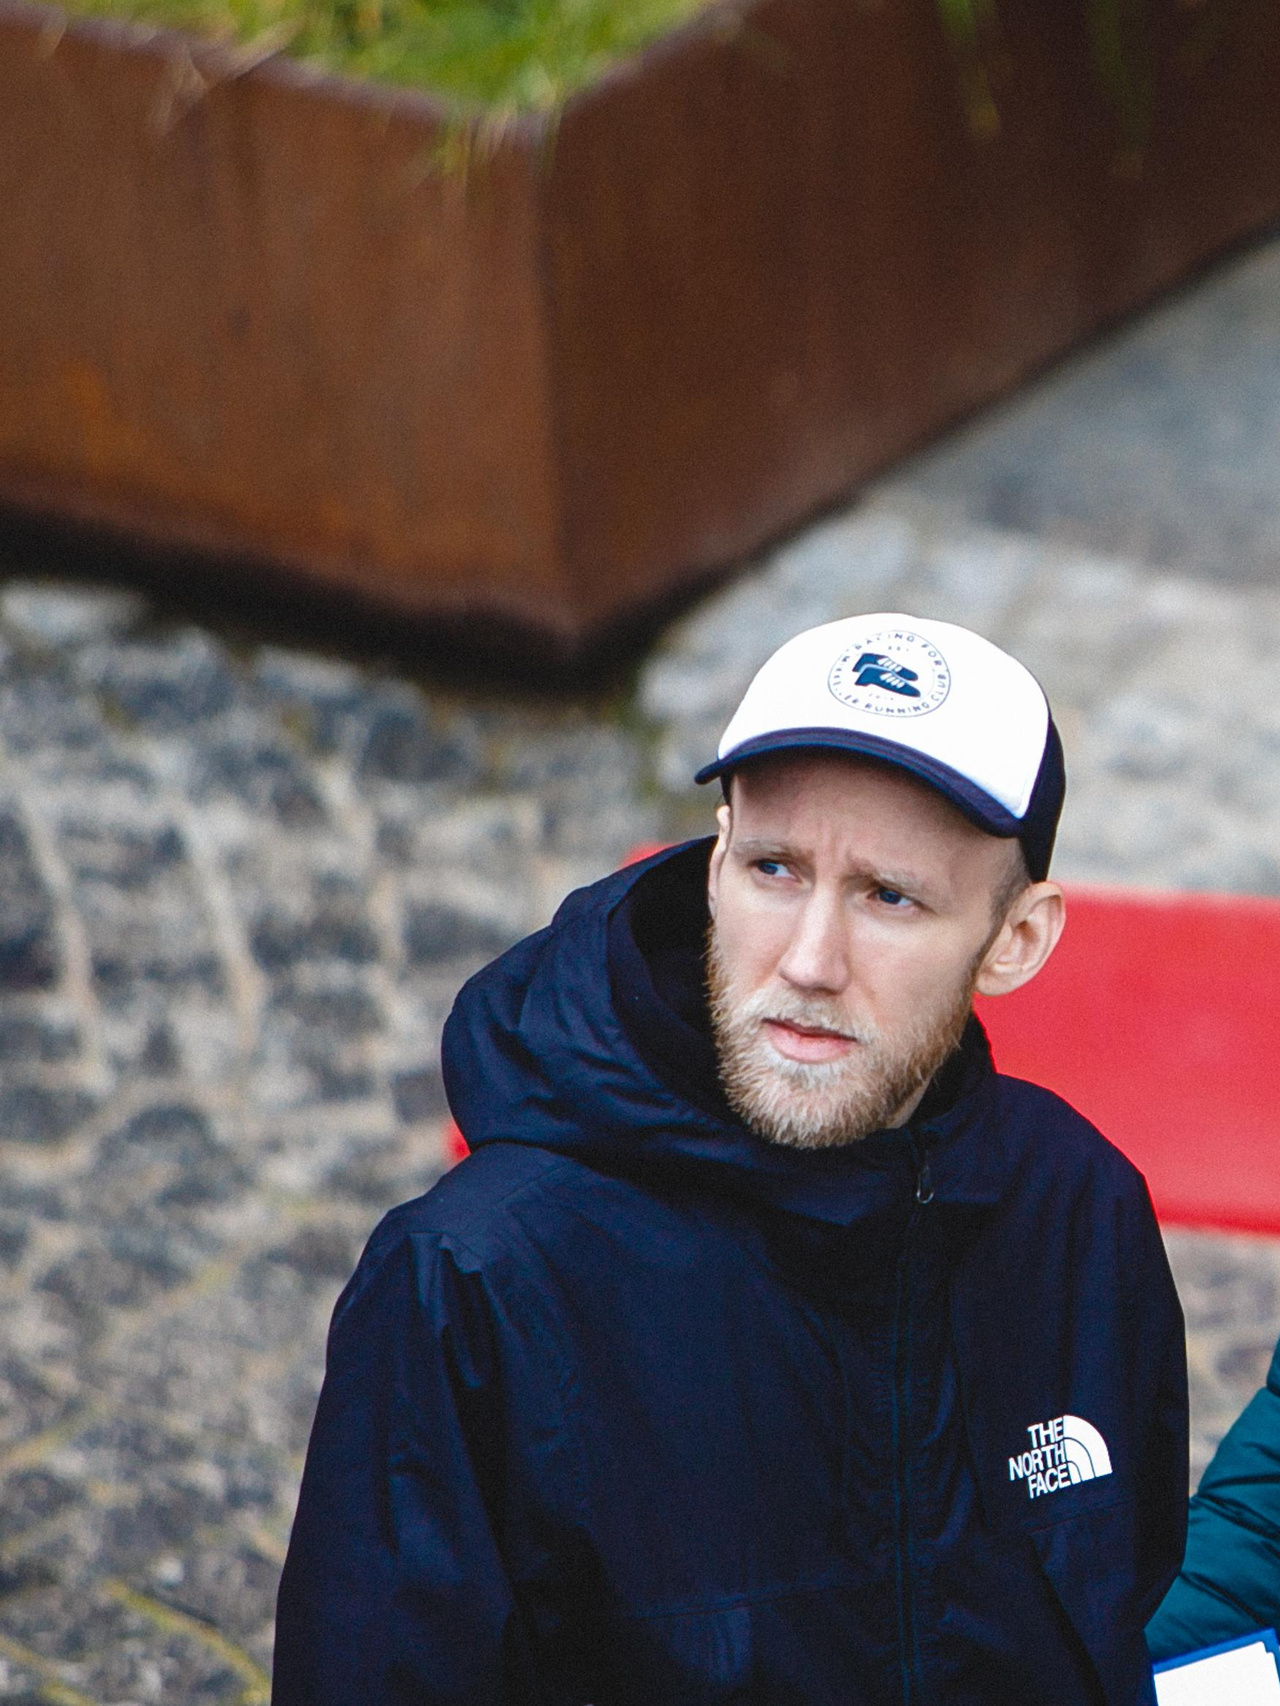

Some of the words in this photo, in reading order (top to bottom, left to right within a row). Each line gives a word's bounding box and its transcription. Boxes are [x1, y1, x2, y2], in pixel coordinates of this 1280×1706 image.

[865, 702, 929, 714] RUNNING
[931, 674, 946, 702] CLUB
[1027, 1417, 1063, 1449] THE
[1008, 1440, 1066, 1481] NORTH
[1027, 1463, 1071, 1499] FACE
